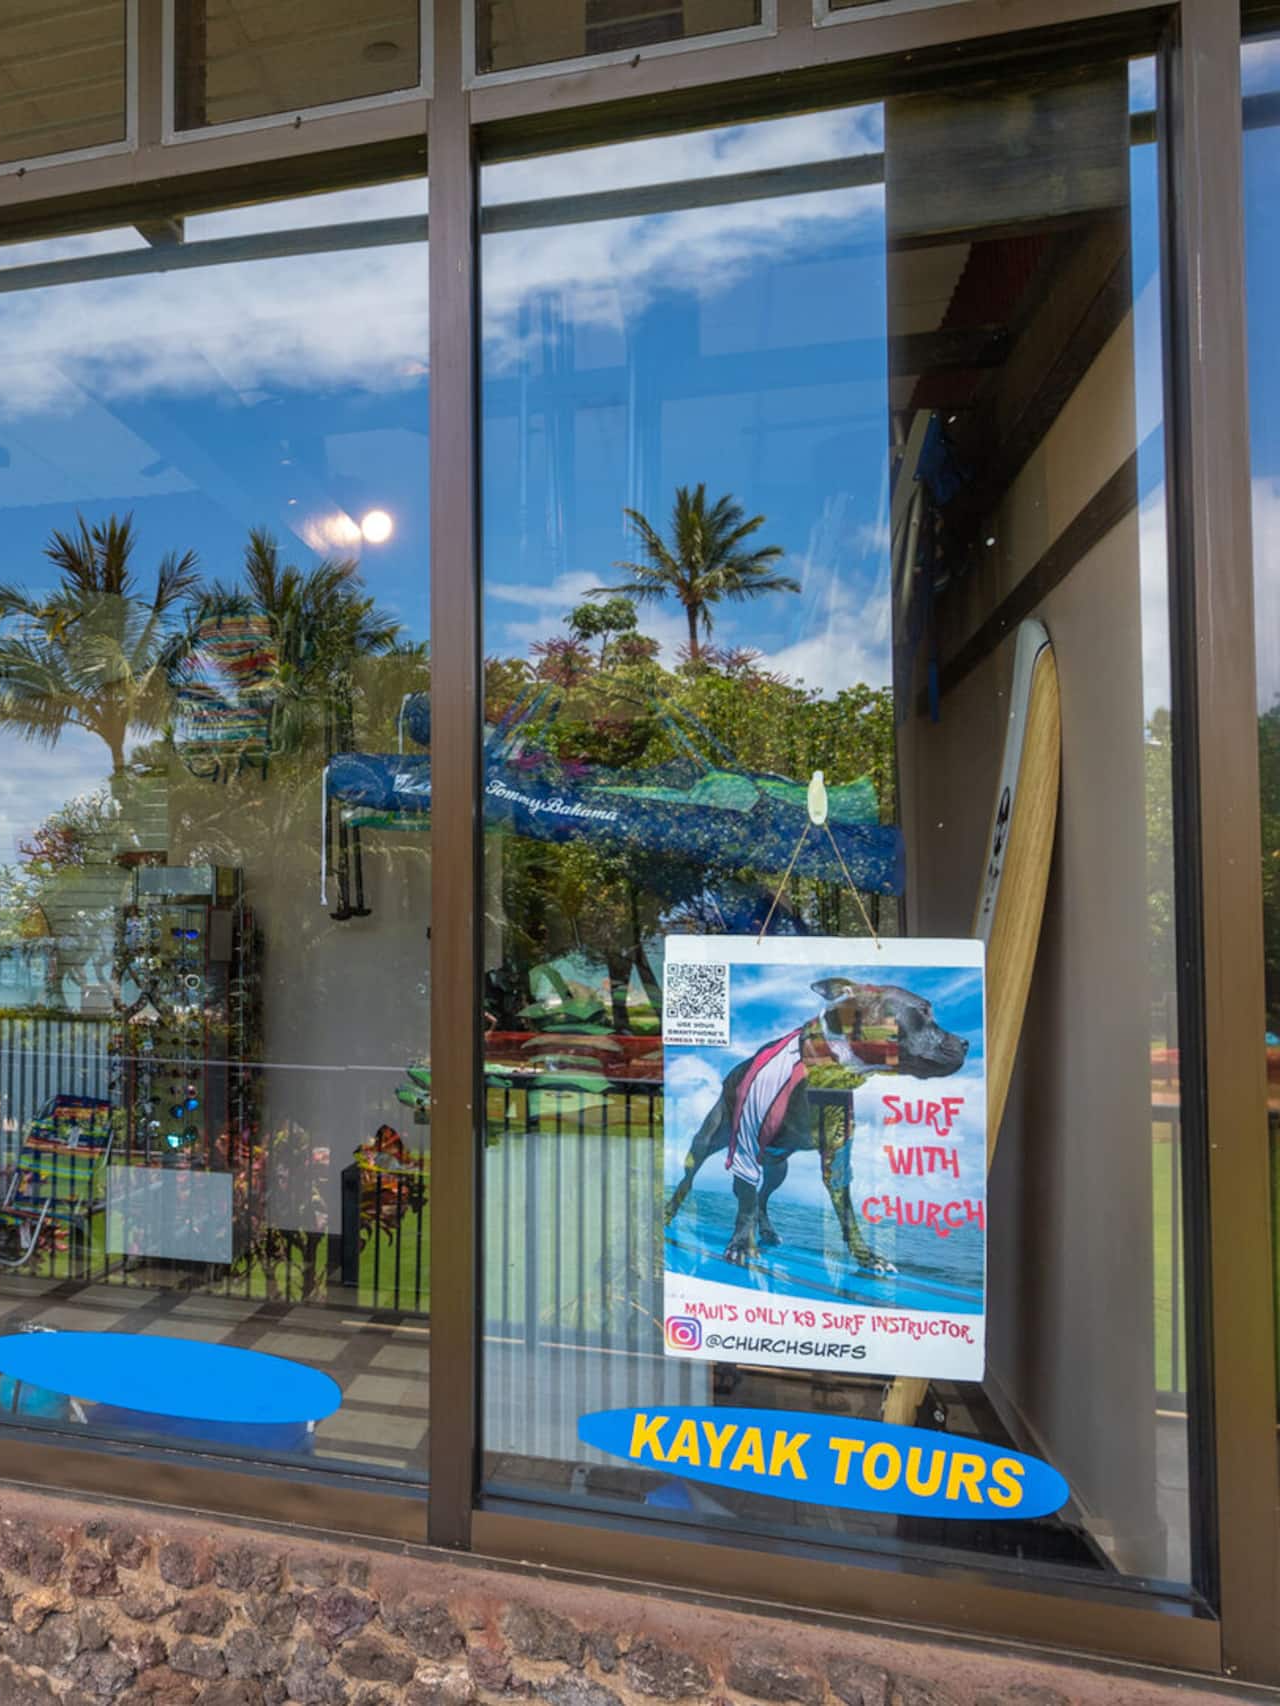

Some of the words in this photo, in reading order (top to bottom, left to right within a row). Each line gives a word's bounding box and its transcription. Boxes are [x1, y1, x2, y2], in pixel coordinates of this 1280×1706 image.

[542, 797, 618, 821] Bahama
[882, 1095, 966, 1137] SURF
[883, 1144, 961, 1179] WITH
[861, 1195, 986, 1238] CHURCH
[683, 1302, 739, 1322] MAUI'S
[745, 1308, 789, 1326] ONLY
[793, 1310, 816, 1328] K9
[822, 1312, 866, 1336] SURF
[871, 1315, 975, 1345] INSTRUCTOR
[705, 1333, 867, 1360] @CHURCHSURFS
[629, 1413, 811, 1480] KAYAK
[828, 1437, 1026, 1509] TOURS
